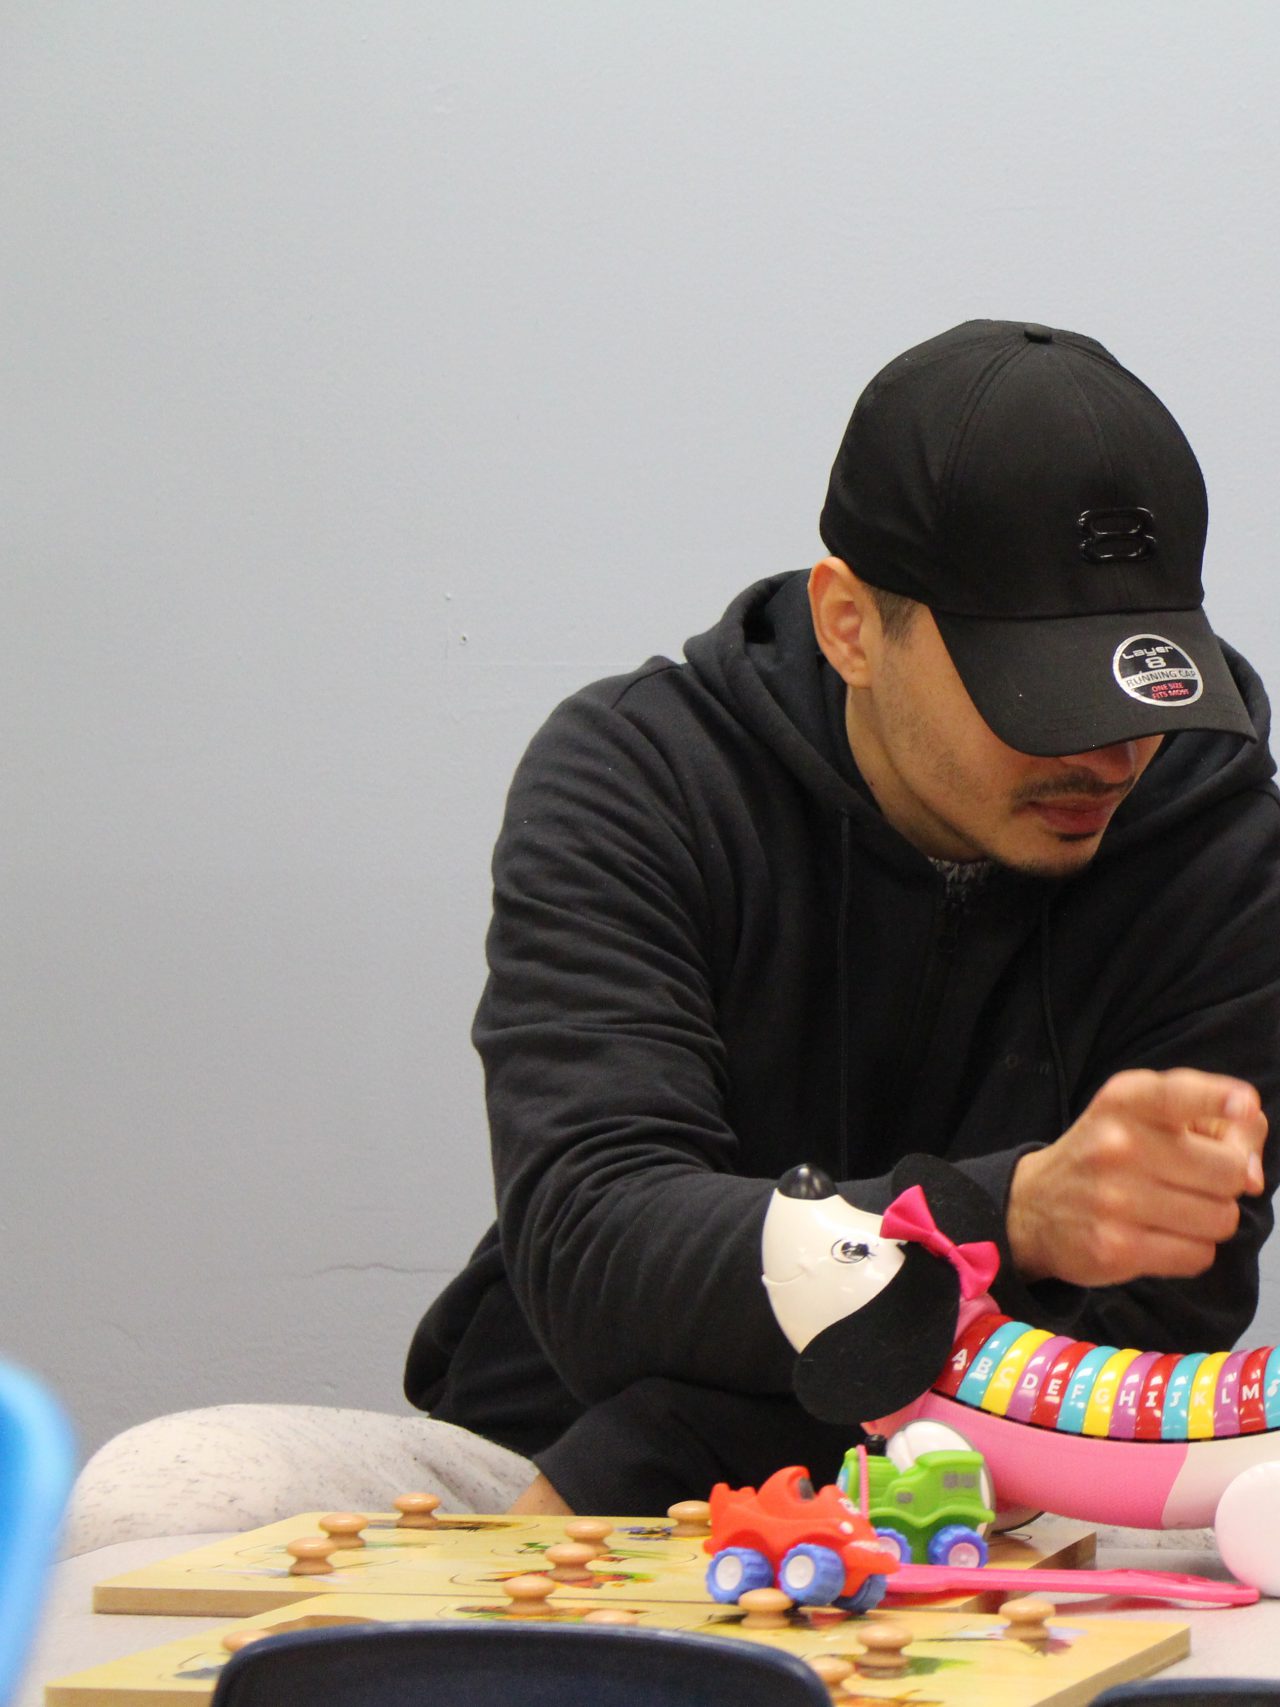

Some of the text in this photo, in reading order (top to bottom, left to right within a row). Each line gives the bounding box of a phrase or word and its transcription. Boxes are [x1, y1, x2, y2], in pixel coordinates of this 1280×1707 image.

[1122, 646, 1174, 660] Layer
[1145, 656, 1166, 669] 8
[1126, 669, 1197, 688] RUNNING CAP
[1151, 682, 1184, 692] ONE SIZE
[1151, 691, 1168, 700] FITS
[952, 1348, 1260, 1408] A B C D E F G H I J K L M
